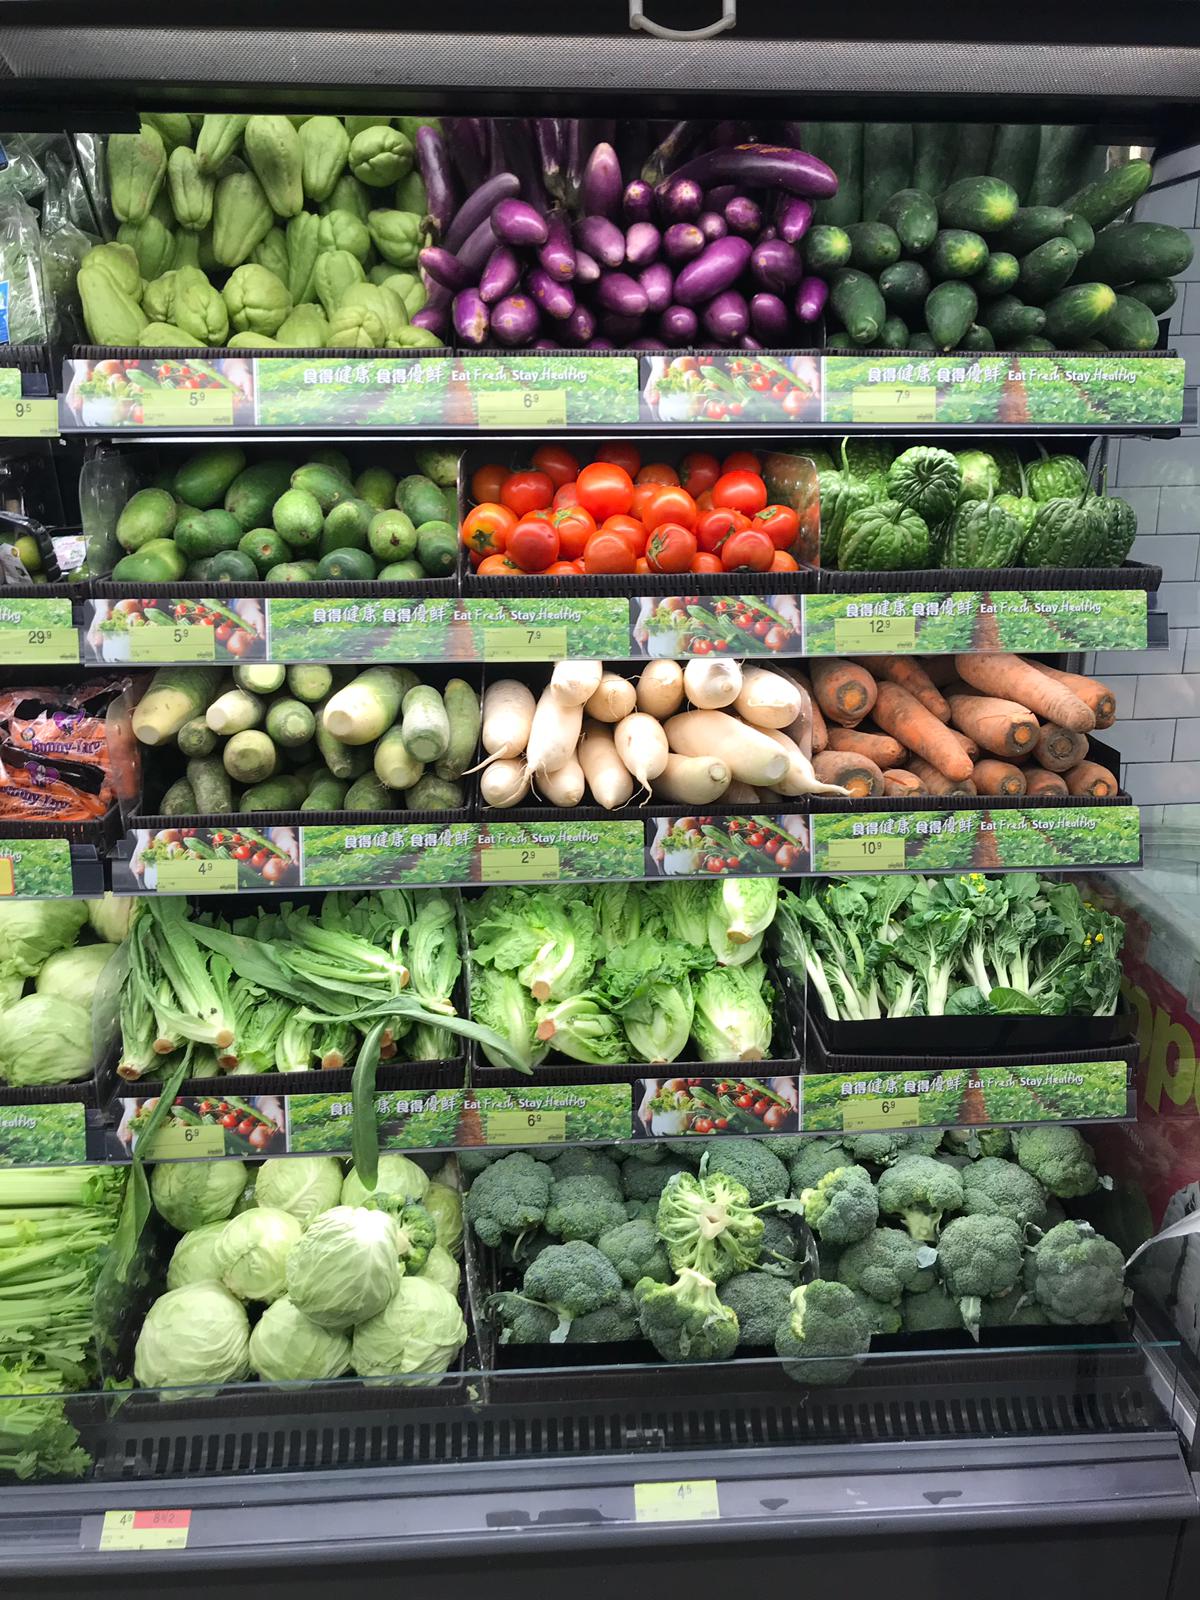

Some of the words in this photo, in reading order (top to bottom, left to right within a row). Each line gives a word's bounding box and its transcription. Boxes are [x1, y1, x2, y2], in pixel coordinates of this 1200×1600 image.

[452, 371, 471, 381] Eat
[474, 366, 506, 381] Fresh
[512, 369, 539, 382] Stay
[541, 366, 587, 383] Healthy
[1008, 371, 1026, 381] Eat
[1029, 366, 1059, 381] Fresh
[1065, 370, 1091, 382] Stay
[1093, 367, 1136, 383] Healthy
[454, 611, 472, 620] Eat
[475, 606, 505, 620] Fresh
[511, 611, 537, 622] Stay
[538, 607, 581, 622] Healthy
[980, 604, 997, 613] Eat
[1000, 598, 1030, 613] Fresh
[1035, 603, 1058, 615] Stay
[1060, 600, 1101, 614] Healthy
[980, 821, 997, 831] Eat
[999, 816, 1028, 830] Fresh
[1032, 820, 1055, 830] Stay
[1056, 816, 1096, 829] Healthy
[478, 835, 496, 844] Eat
[498, 832, 528, 844] Fresh
[532, 834, 556, 844] Stay
[557, 830, 599, 843] Healthy
[968, 1080, 985, 1089] Eat
[987, 1074, 1015, 1088] Fresh
[1020, 1077, 1043, 1087] Stay
[1043, 1073, 1084, 1085] Healthy
[464, 1100, 481, 1110] Eat
[483, 1096, 513, 1109] Fresh
[518, 1099, 543, 1109] Stay
[542, 1096, 586, 1108] Healthy
